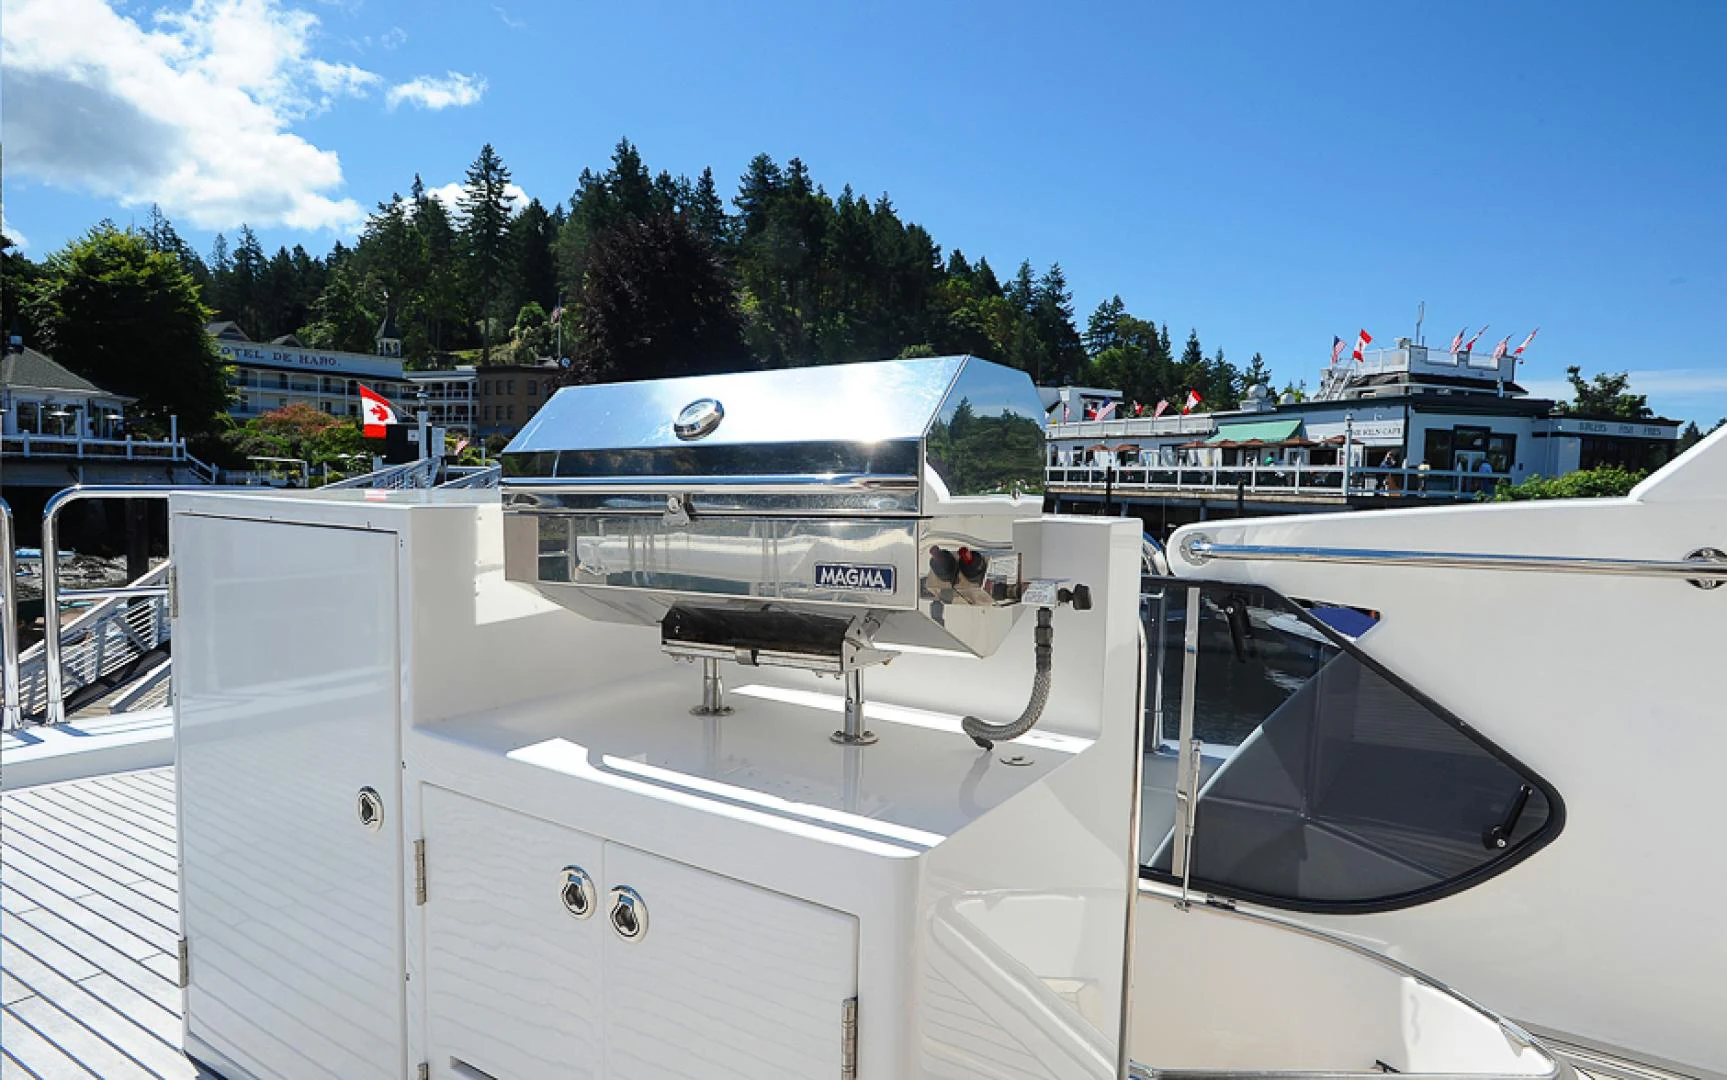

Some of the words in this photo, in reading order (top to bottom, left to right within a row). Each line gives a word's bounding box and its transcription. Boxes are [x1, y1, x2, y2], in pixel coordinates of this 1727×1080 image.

[221, 346, 264, 360] OTEL
[273, 351, 292, 362] DE
[820, 566, 886, 589] MAGMA
